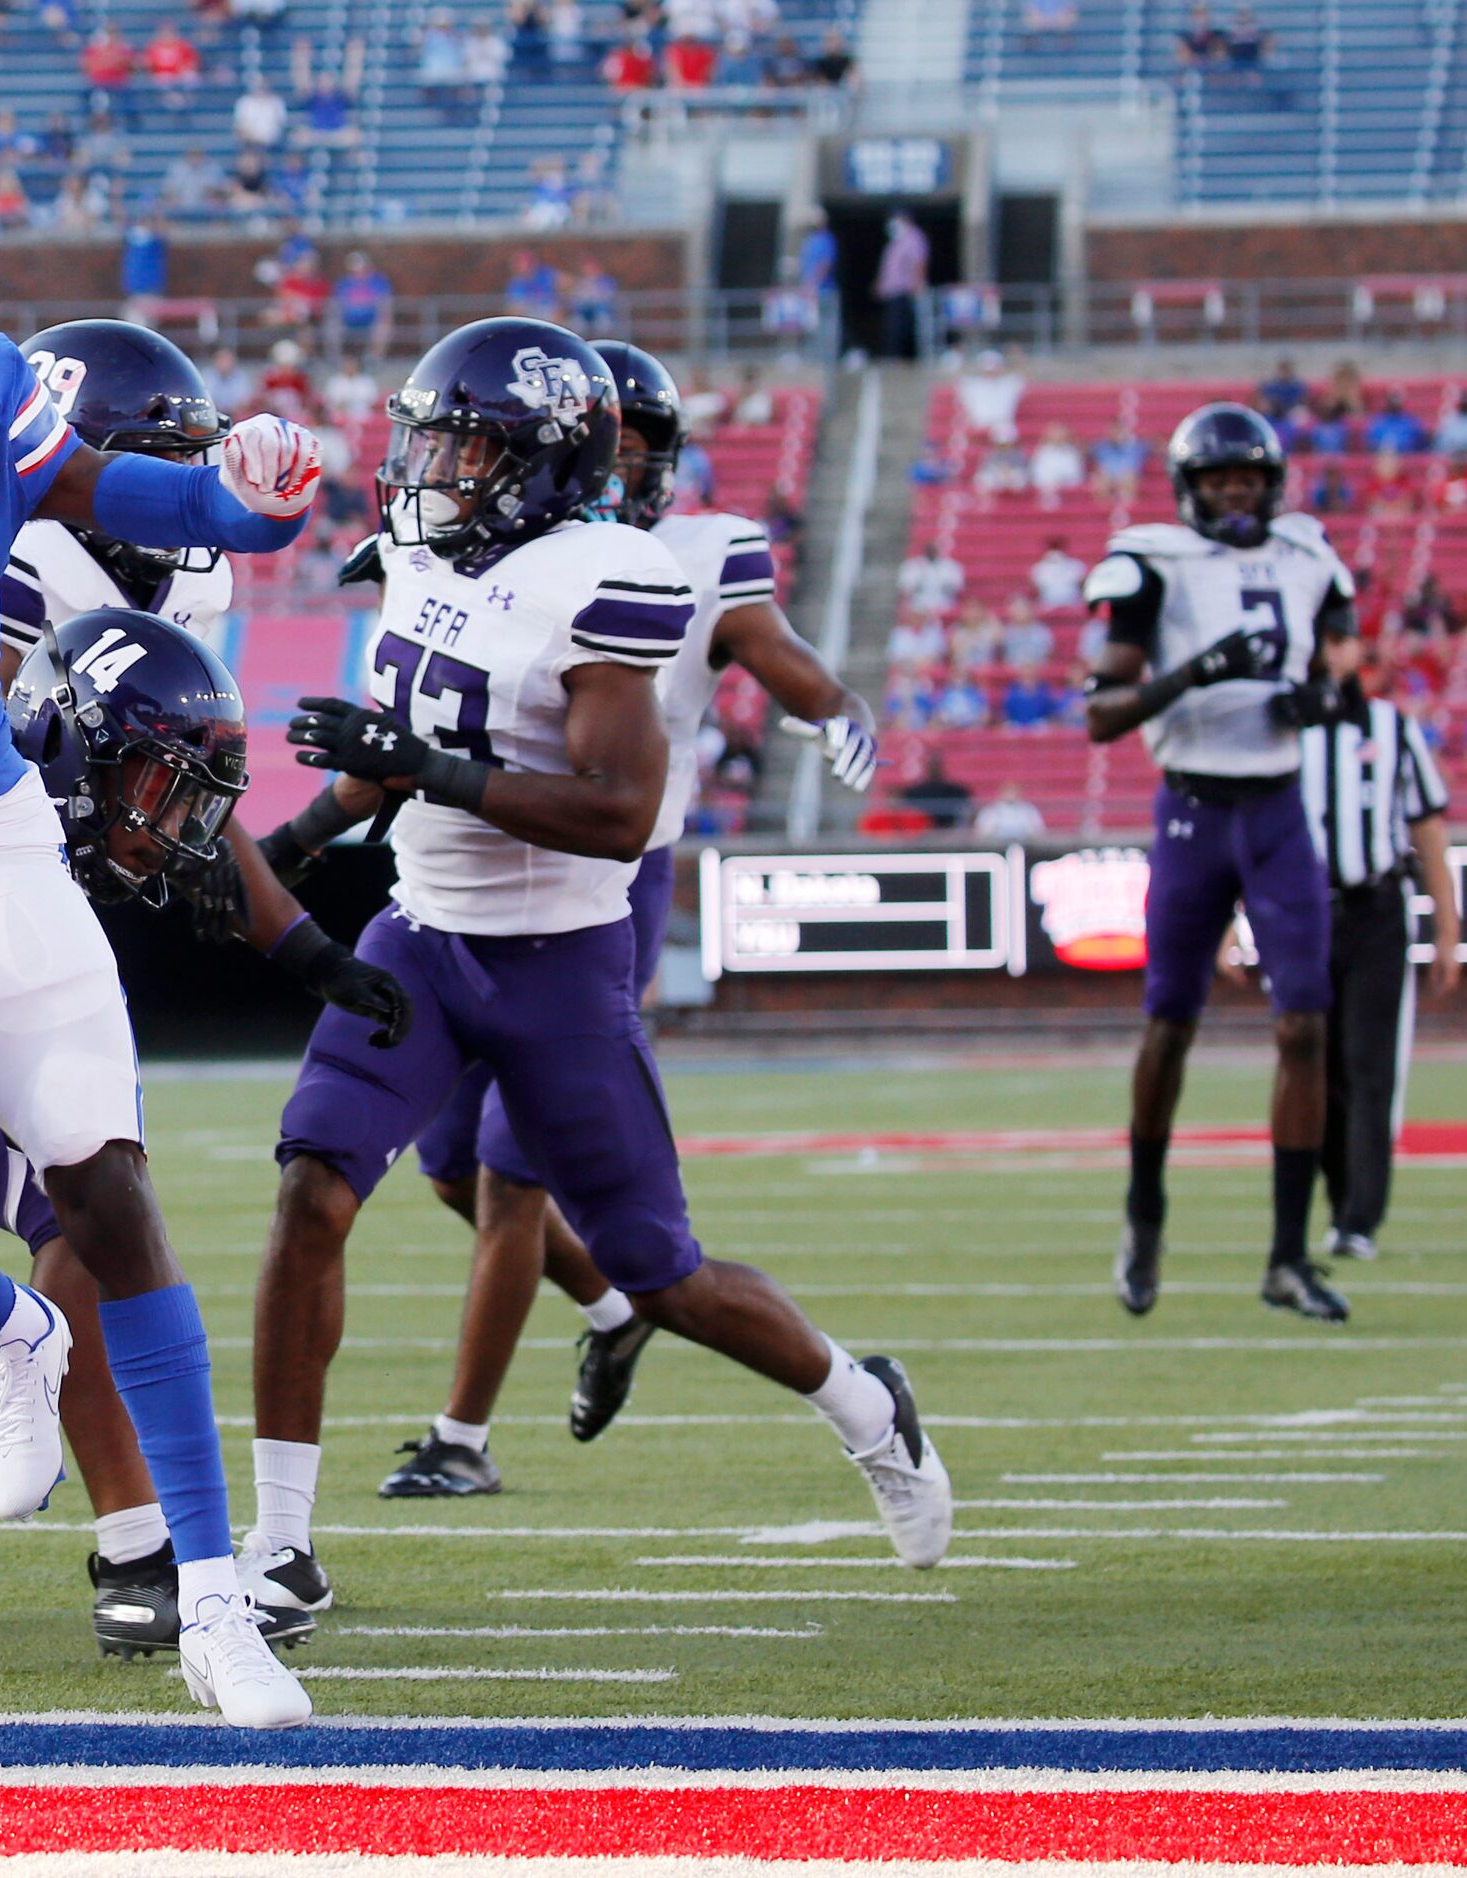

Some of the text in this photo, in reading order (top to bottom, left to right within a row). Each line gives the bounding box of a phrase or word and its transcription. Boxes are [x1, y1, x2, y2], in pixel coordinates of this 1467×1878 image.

[520, 355, 581, 409] SFA
[413, 597, 469, 648] SFA
[71, 628, 149, 694] 14
